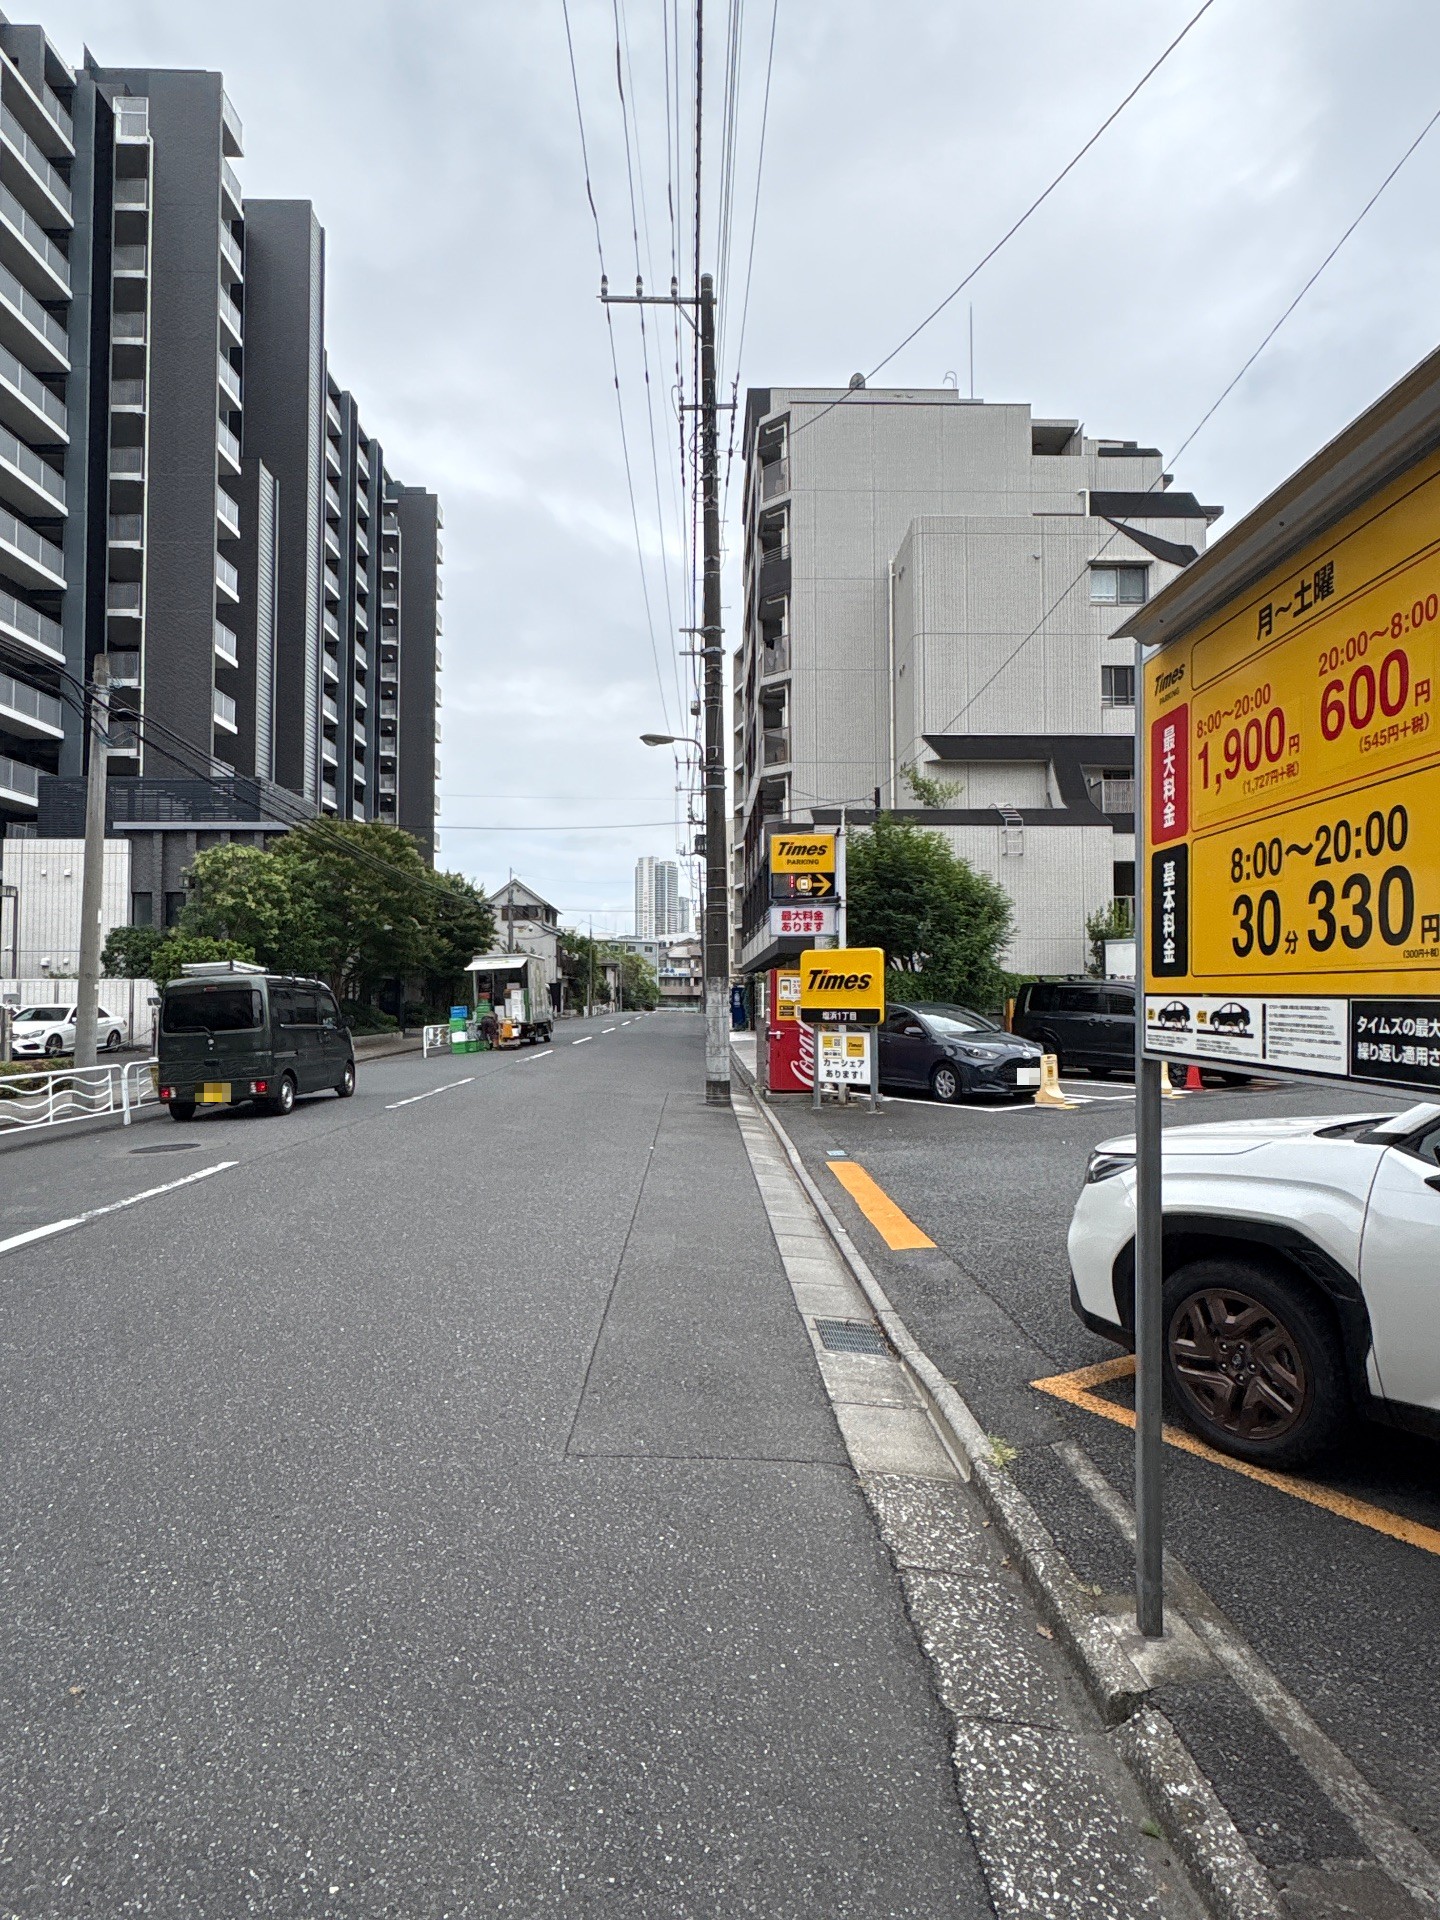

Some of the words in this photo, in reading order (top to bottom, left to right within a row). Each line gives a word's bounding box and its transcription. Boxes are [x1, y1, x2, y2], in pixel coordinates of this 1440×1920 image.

[1155, 663, 1185, 696] Times
[1320, 648, 1431, 741] 600円
[1197, 706, 1300, 796] 1,900円
[1162, 724, 1175, 829] 最大料金
[778, 842, 828, 856] Times
[781, 911, 824, 921] 最大料金
[781, 922, 824, 932] あります
[1162, 860, 1175, 963] 基本料金
[1231, 888, 1299, 958] 30分
[808, 969, 872, 990] Times
[823, 1059, 865, 1068] カーシェア
